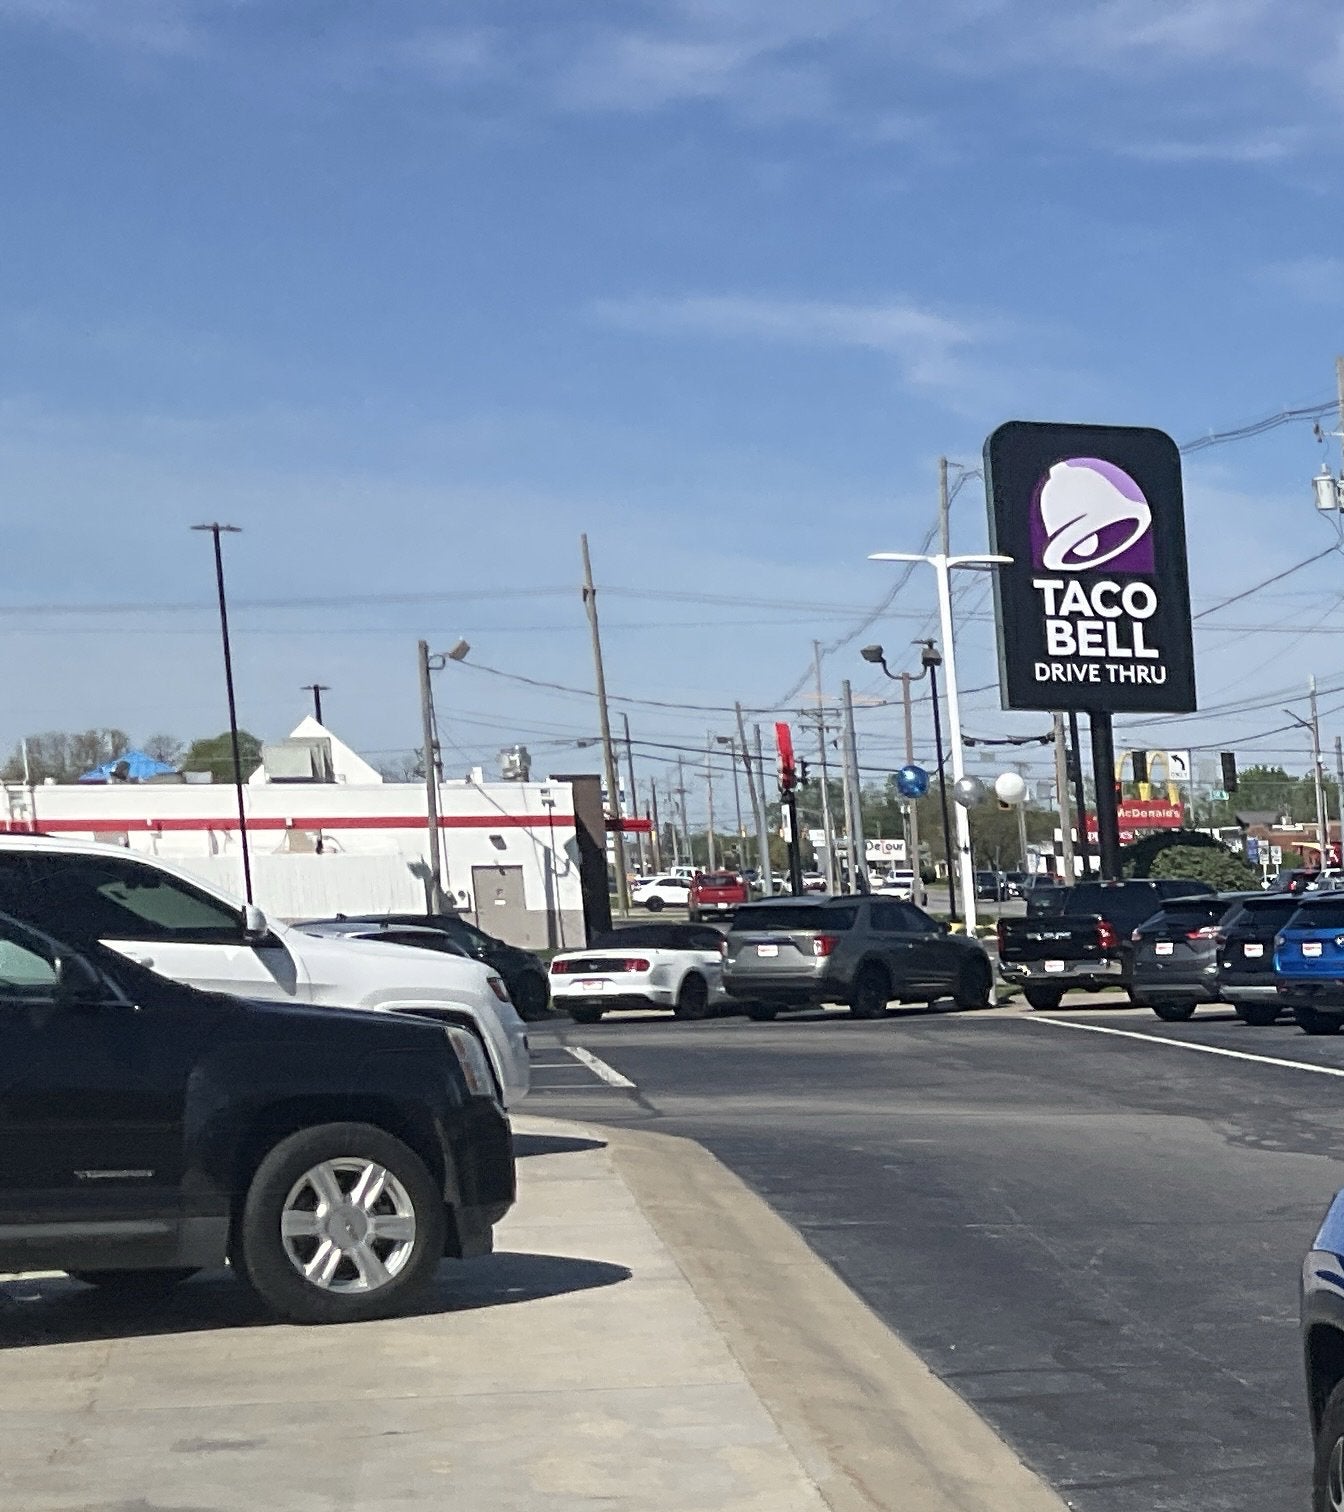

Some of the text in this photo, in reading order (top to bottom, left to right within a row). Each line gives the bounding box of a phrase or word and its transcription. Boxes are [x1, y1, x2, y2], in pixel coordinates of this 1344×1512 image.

[1033, 579, 1158, 619] TACO
[1045, 619, 1159, 658] BELL
[1034, 662, 1167, 684] DRIVE THRU
[1117, 808, 1180, 818] McDonald's
